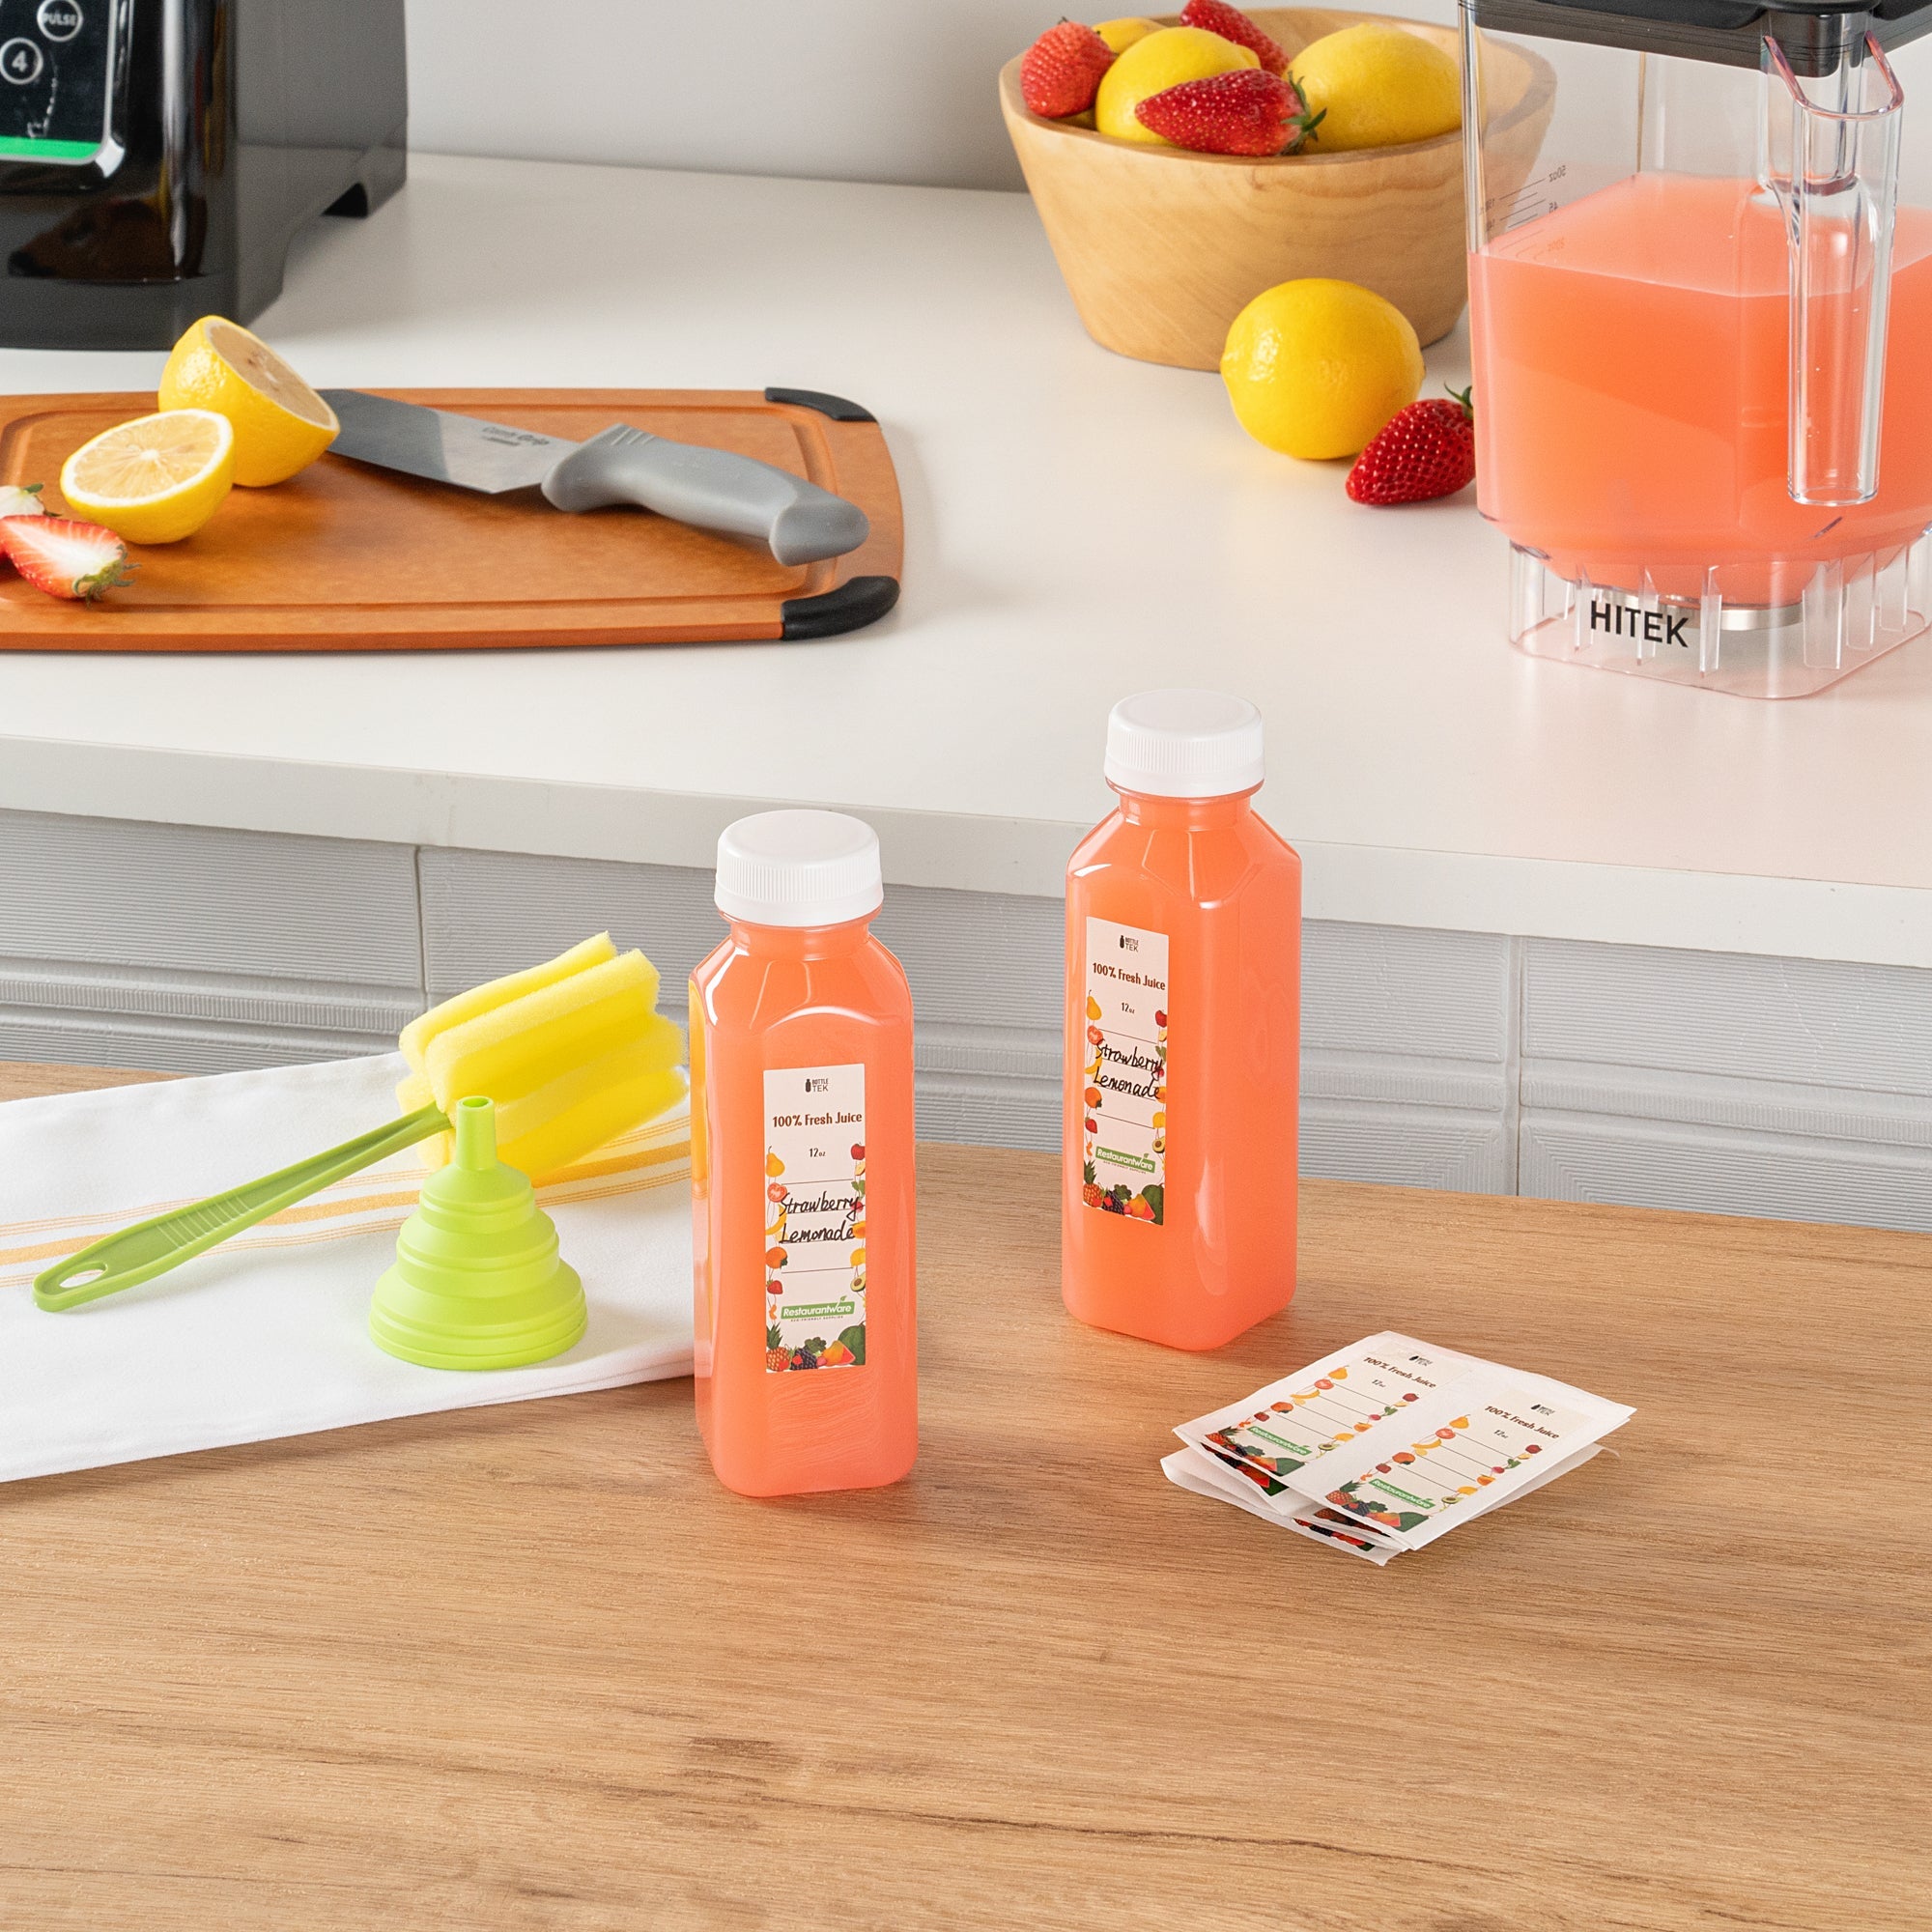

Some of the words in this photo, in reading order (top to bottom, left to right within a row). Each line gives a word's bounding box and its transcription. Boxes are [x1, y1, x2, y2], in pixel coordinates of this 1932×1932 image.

[43, 13, 77, 26] PULSE
[12, 50, 28, 72] 4
[1591, 600, 1689, 648] HITEK
[1093, 962, 1117, 979] 100%
[1118, 968, 1141, 985] Fresh
[1143, 975, 1166, 990] Juice
[1095, 1038, 1162, 1081] Strawberry
[812, 1084, 829, 1093] TEK
[1094, 1066, 1160, 1099] Lemonade
[772, 1114, 803, 1128] 100%
[805, 1113, 833, 1126] Fresh
[835, 1112, 863, 1124] Juice
[1097, 1149, 1153, 1171] Restaurantware
[779, 1190, 860, 1222] Strawberry
[779, 1220, 856, 1244] Lemonade
[783, 1302, 852, 1317] Restaurantware
[1363, 1357, 1390, 1370] 100%
[1388, 1366, 1412, 1379] Fresh
[1411, 1377, 1436, 1388] Juice
[1485, 1406, 1511, 1419] 100%
[1509, 1415, 1535, 1430] Fresh
[1534, 1427, 1559, 1438] Juice
